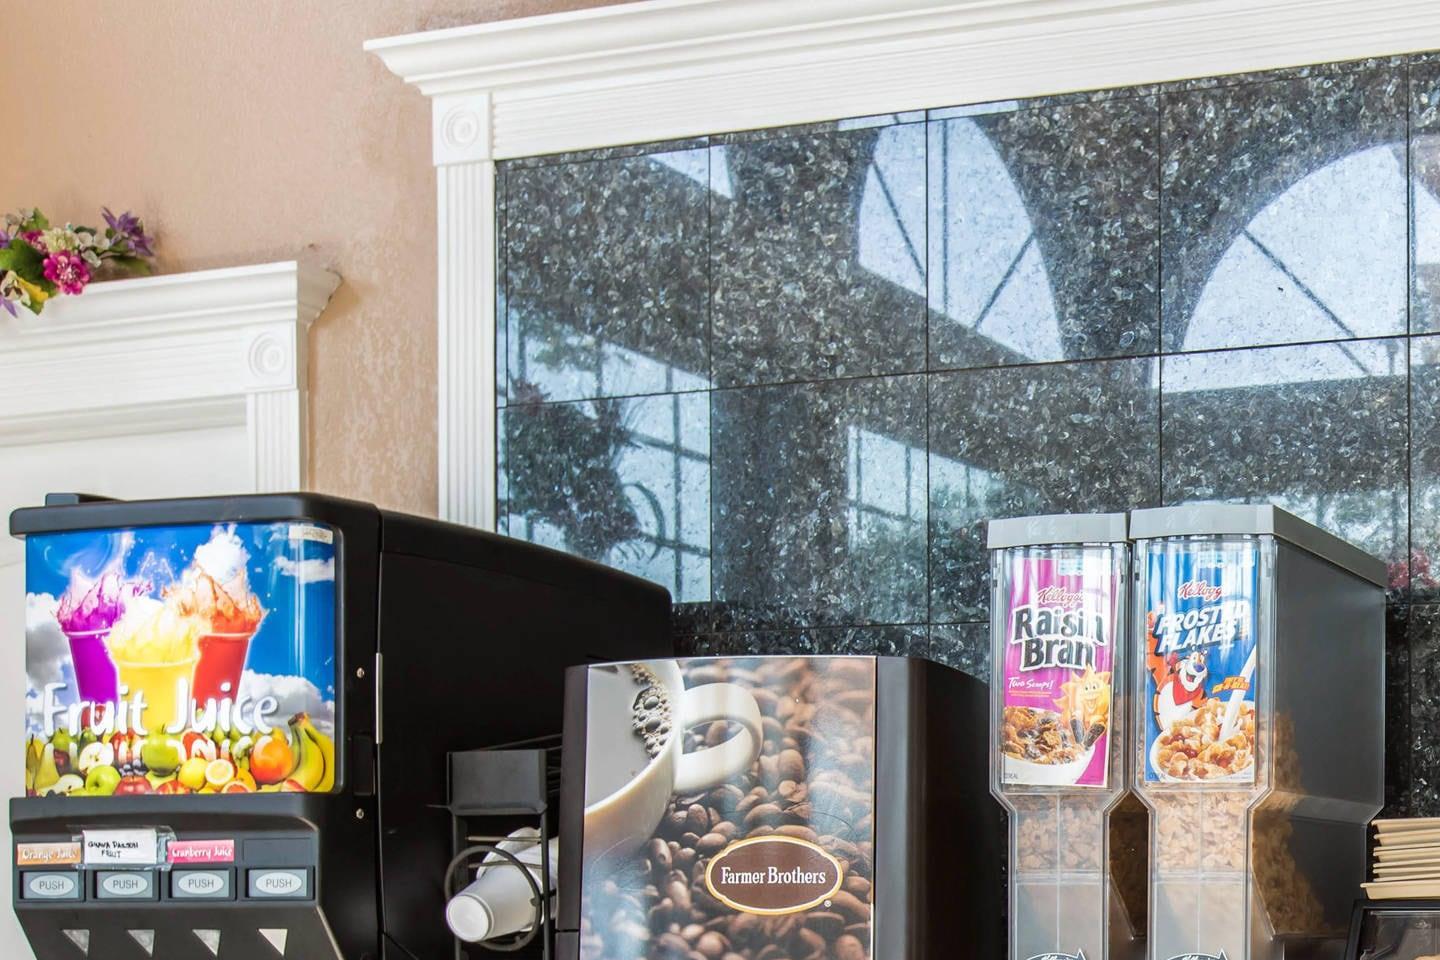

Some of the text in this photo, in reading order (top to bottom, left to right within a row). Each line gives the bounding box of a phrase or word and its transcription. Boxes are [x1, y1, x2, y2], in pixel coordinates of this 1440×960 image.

[1012, 606, 1105, 643] Raisin
[1022, 638, 1094, 669] Bran
[43, 678, 279, 736] Fruit Juice
[172, 846, 233, 859] Cranberry Juice
[721, 866, 826, 884] Farmer Brothers
[39, 881, 65, 890] PUSH
[112, 880, 138, 889] PUSH
[188, 879, 214, 888] PUSH
[265, 879, 292, 887] PUSH
